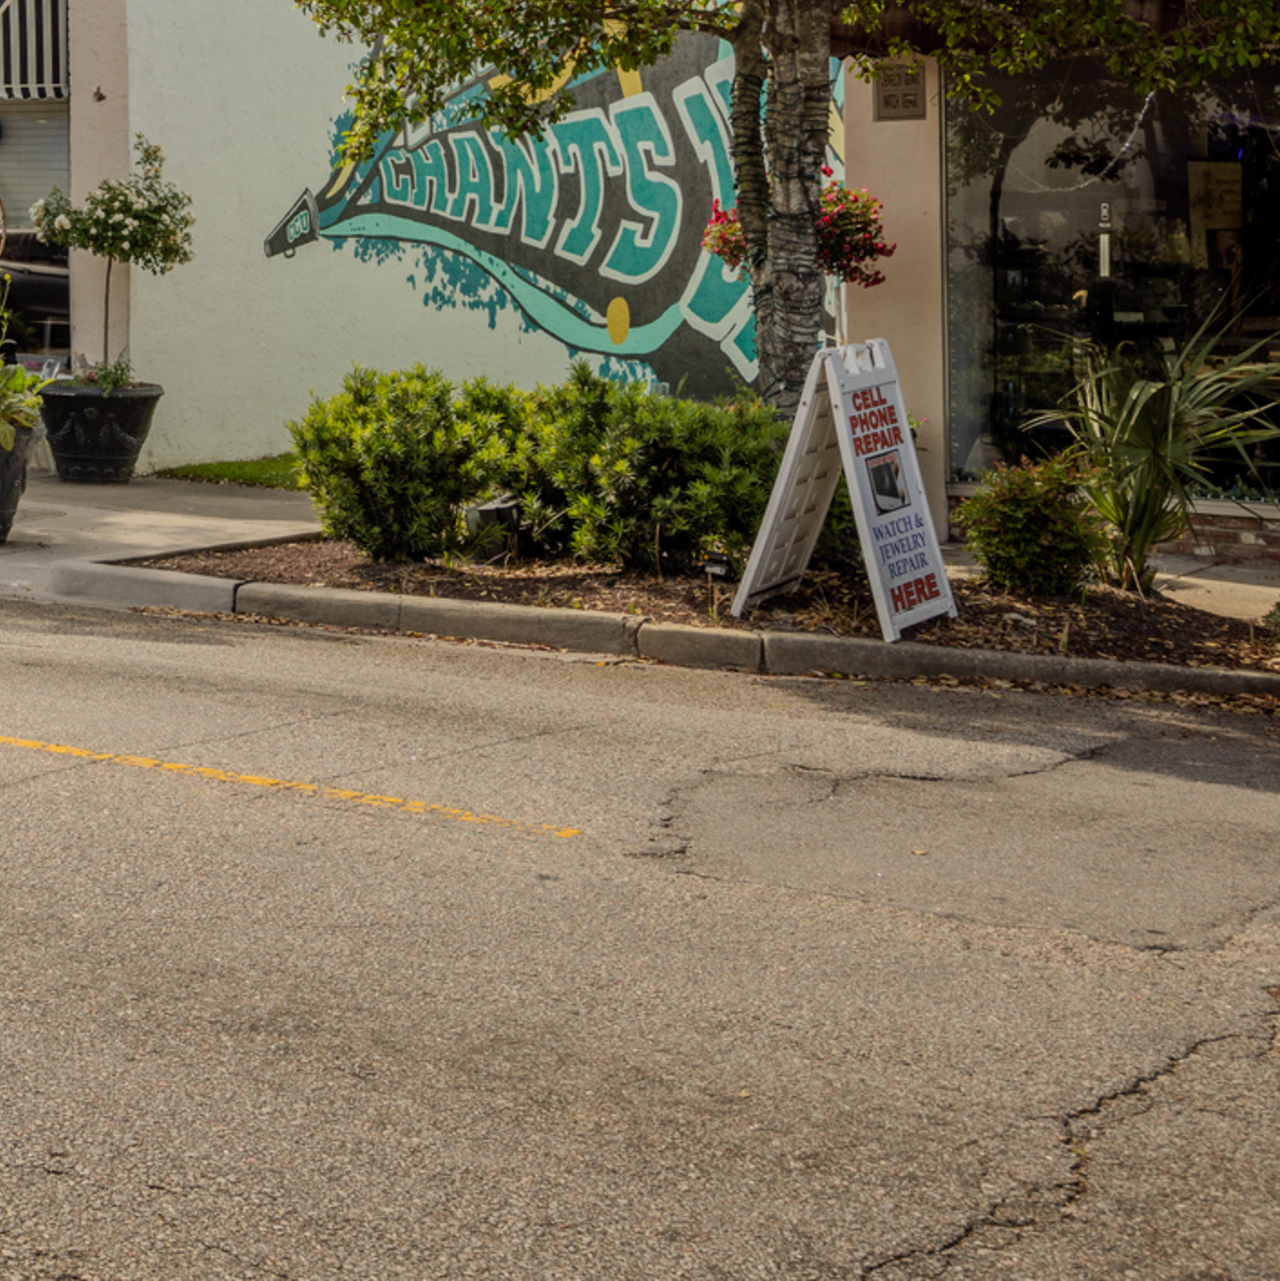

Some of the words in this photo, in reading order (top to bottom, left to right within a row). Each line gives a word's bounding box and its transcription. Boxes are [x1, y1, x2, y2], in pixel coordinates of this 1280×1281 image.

[380, 91, 682, 284] CHANTS
[286, 210, 309, 243] CCU
[852, 387, 887, 412] CELL
[849, 405, 898, 435] PHONE
[852, 426, 904, 457] REPAIR
[872, 517, 913, 542] WATCH
[914, 513, 925, 528] &
[880, 532, 927, 566] JEWELRY
[888, 552, 929, 579] REPAIR
[890, 573, 941, 613] HERE
